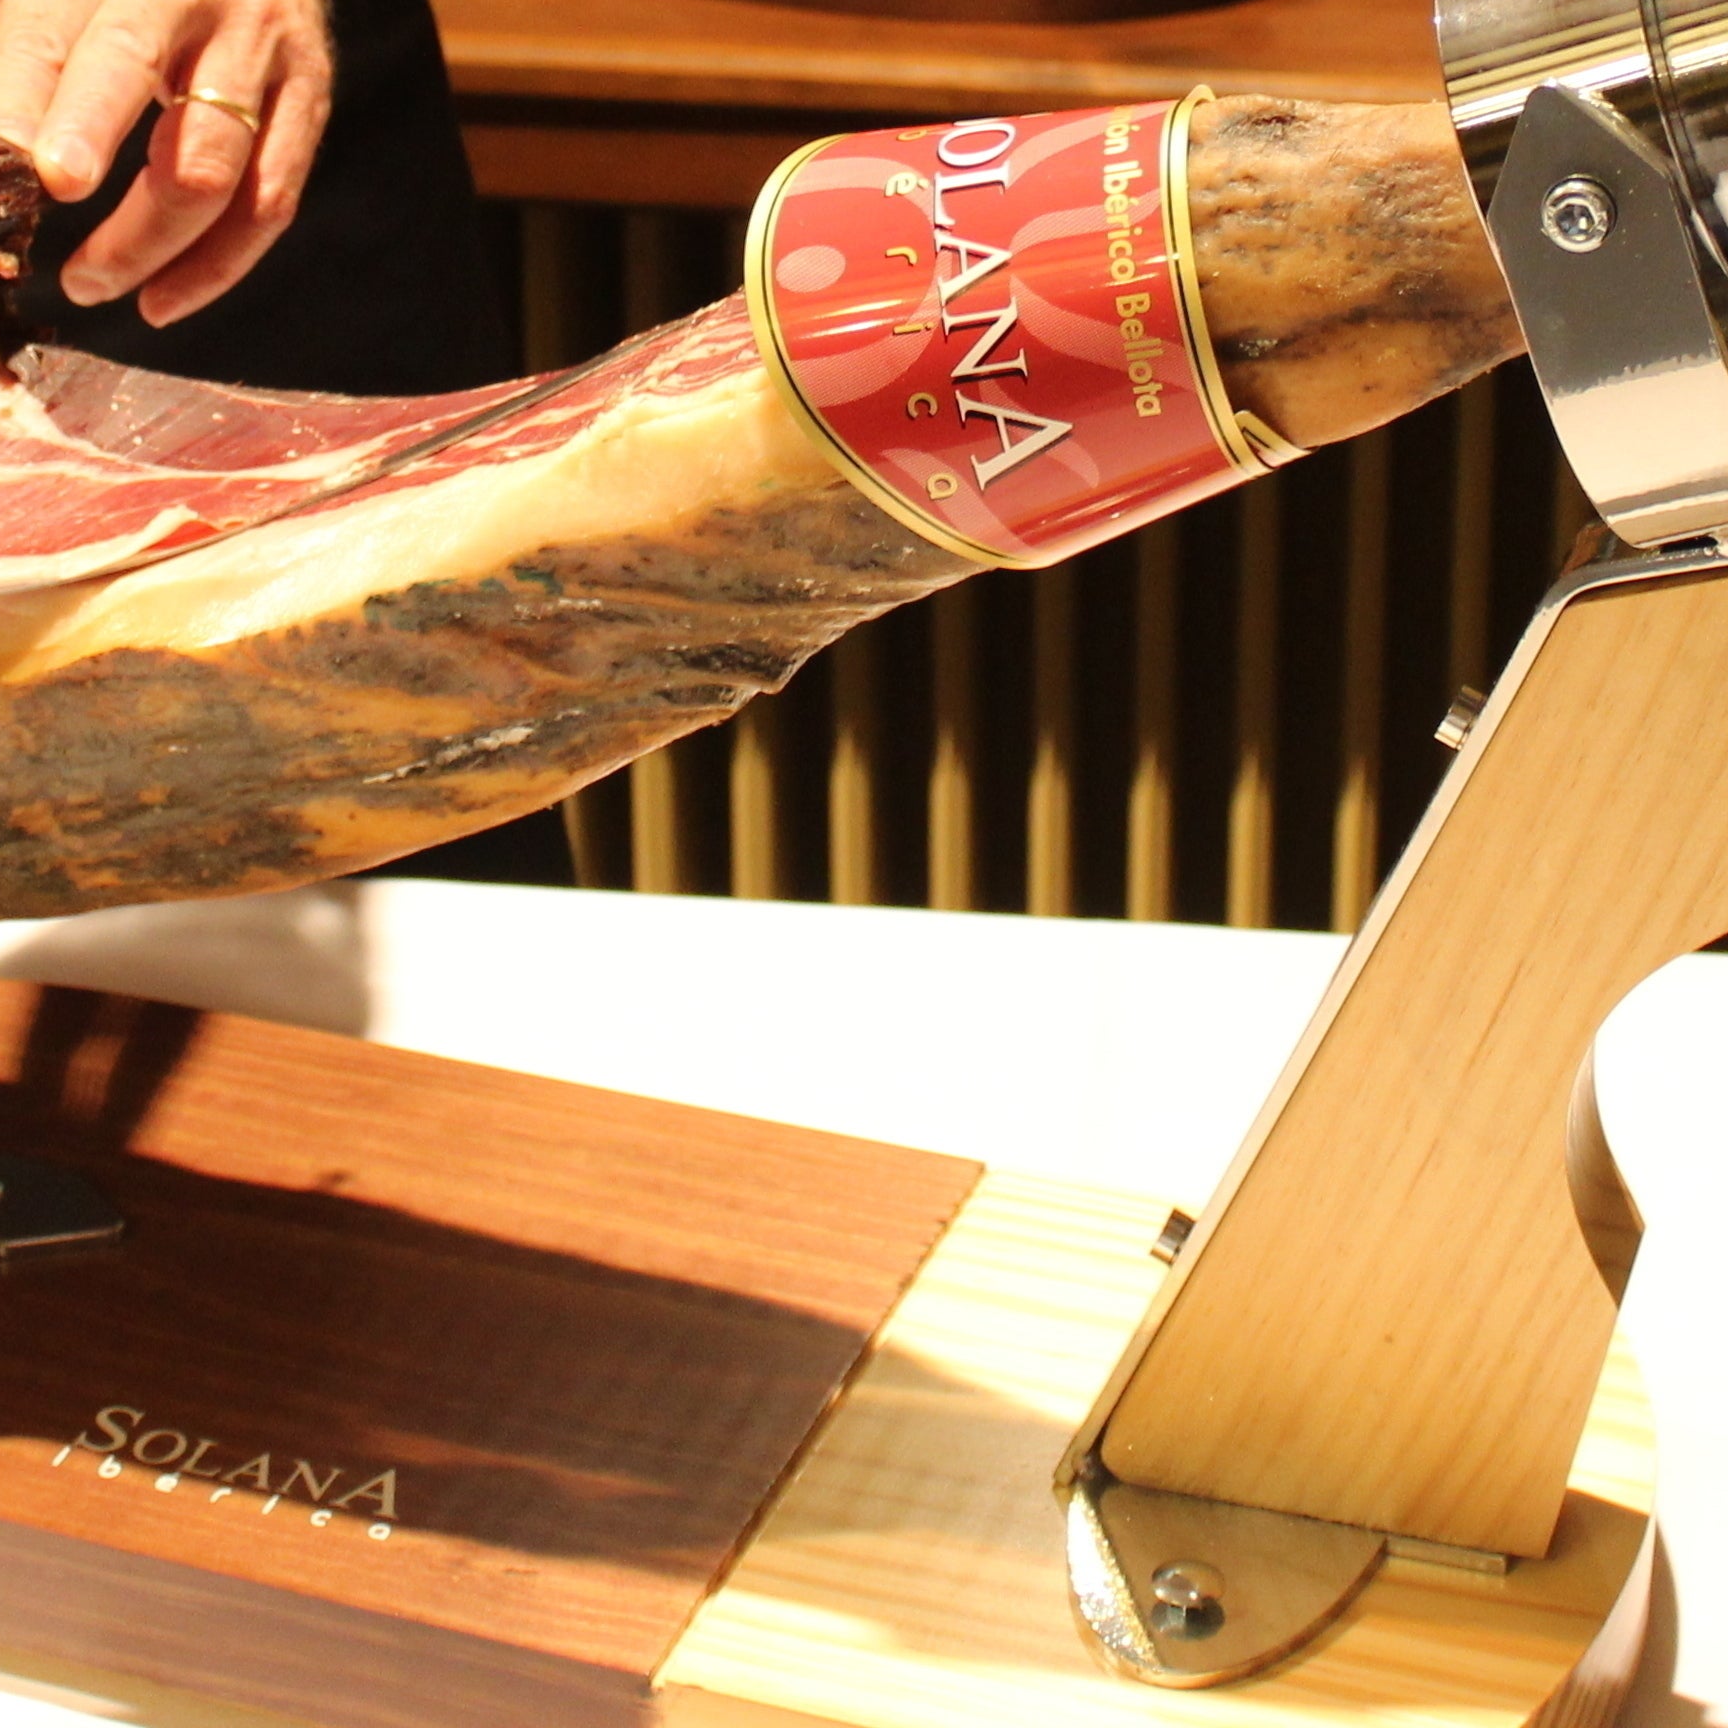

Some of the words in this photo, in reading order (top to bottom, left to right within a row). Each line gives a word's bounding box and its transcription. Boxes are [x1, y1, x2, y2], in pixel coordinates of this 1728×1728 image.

[1102, 160, 1143, 287] Ibérico
[883, 127, 959, 501] bérica
[933, 119, 1074, 491] OLANA
[1114, 291, 1162, 419] Bellota
[74, 1404, 400, 1520] SOLANA
